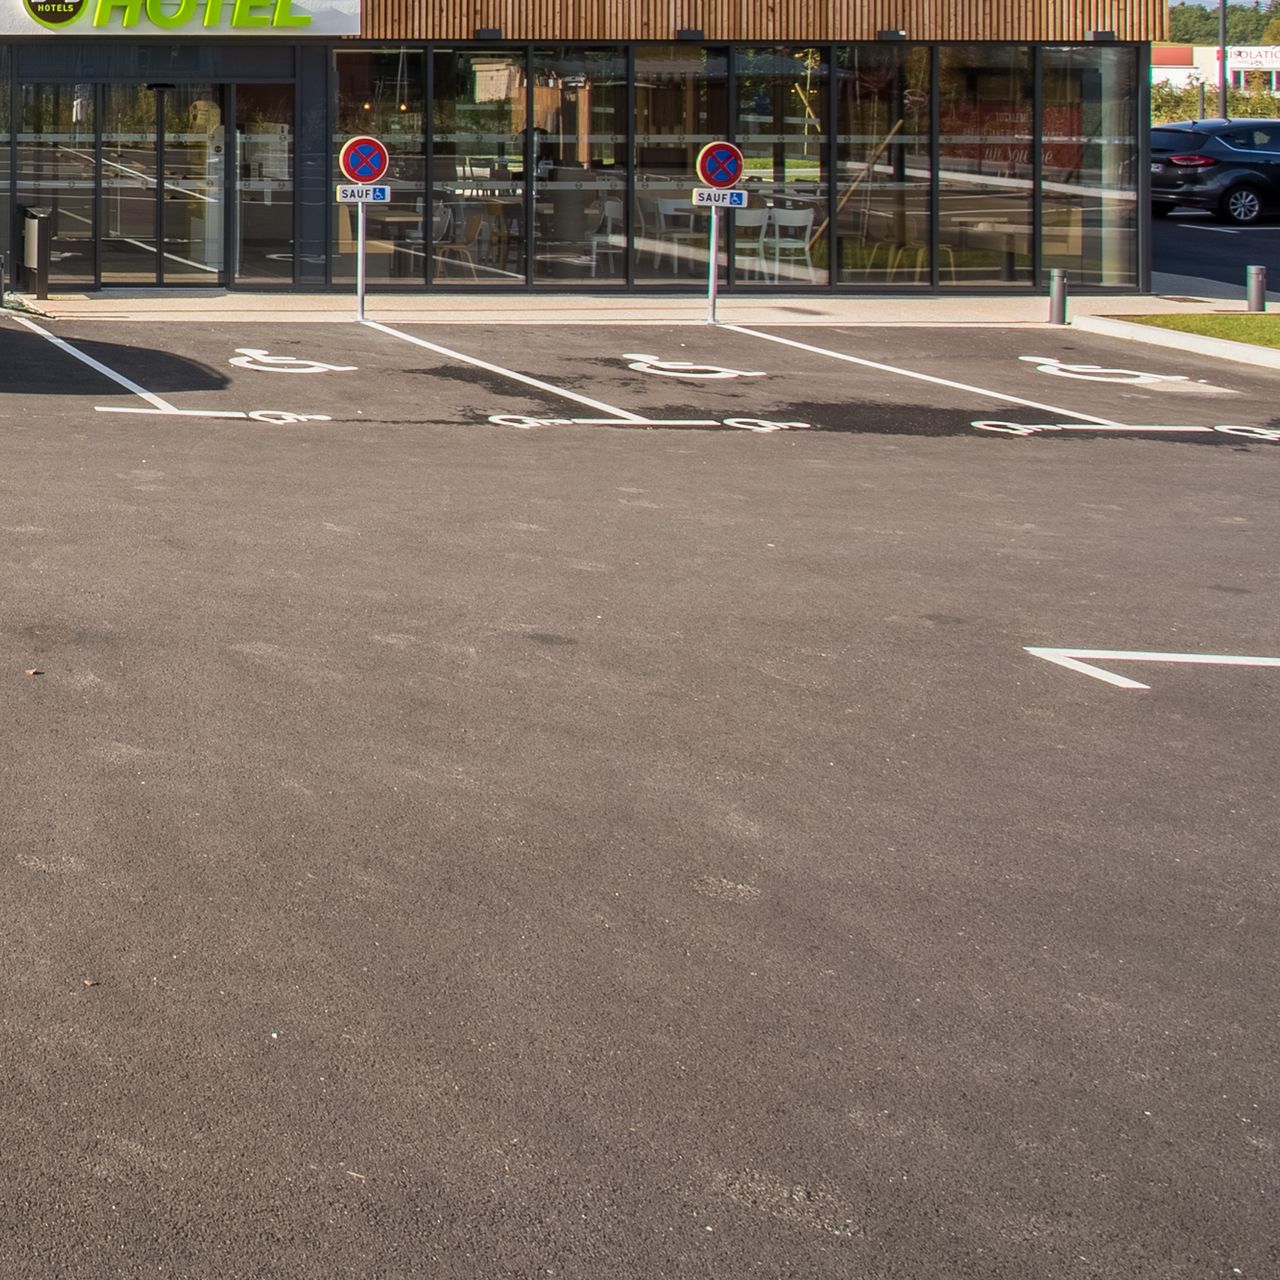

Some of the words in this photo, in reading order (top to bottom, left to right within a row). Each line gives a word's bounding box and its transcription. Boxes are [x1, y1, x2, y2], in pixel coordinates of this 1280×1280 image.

[37, 3, 74, 12] HOTELS
[342, 189, 371, 199] SAUF
[698, 192, 728, 202] SAUF
